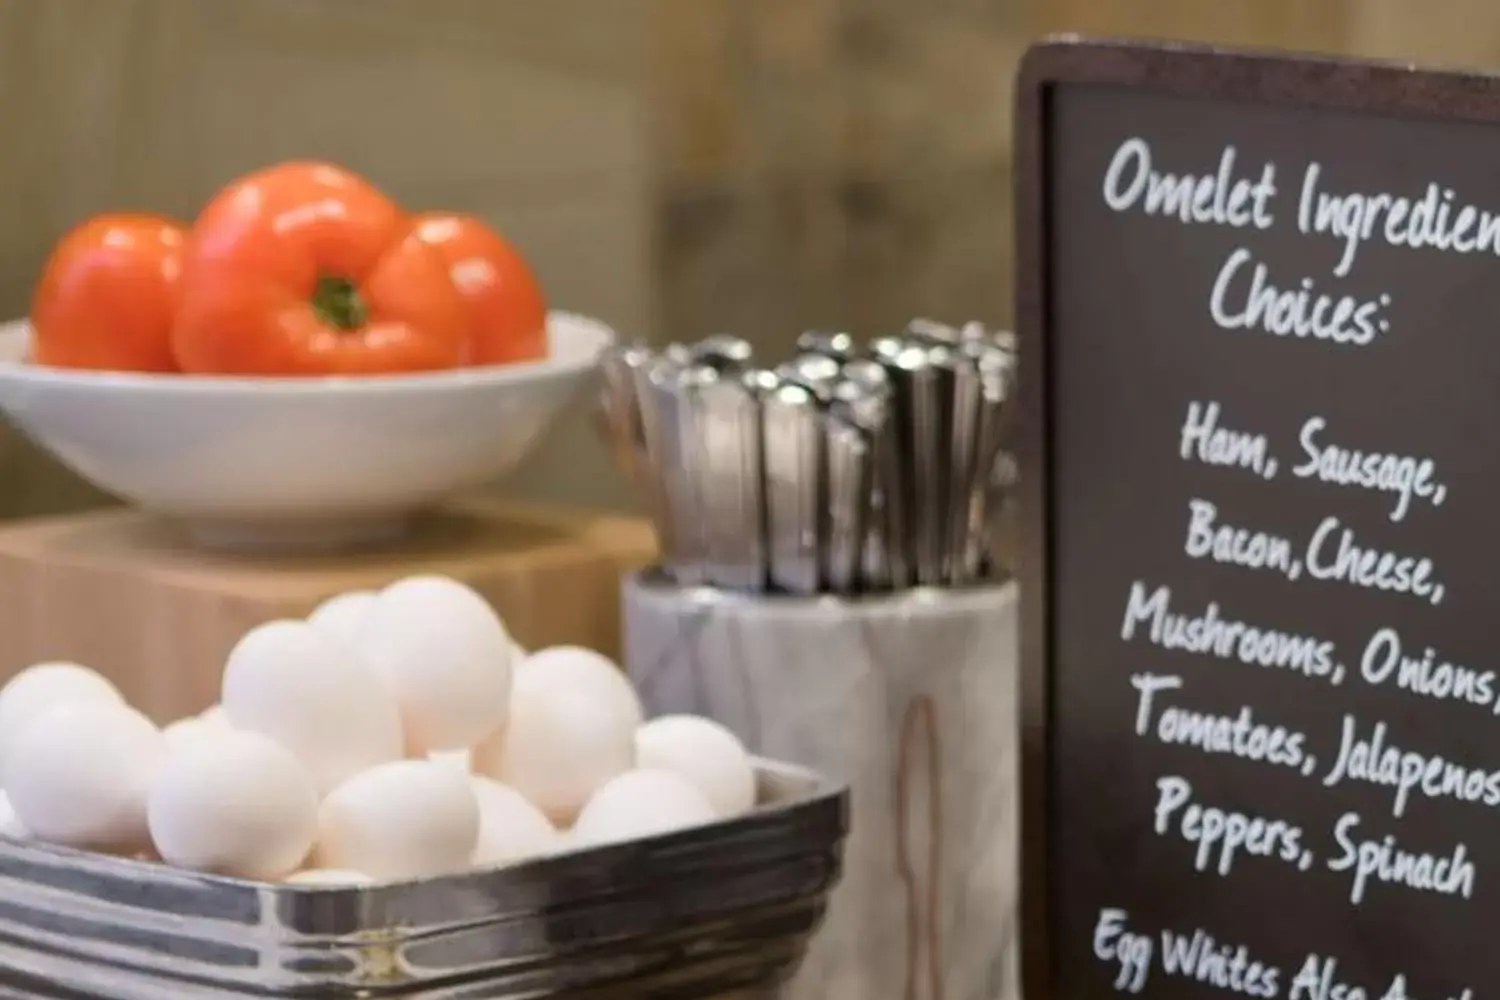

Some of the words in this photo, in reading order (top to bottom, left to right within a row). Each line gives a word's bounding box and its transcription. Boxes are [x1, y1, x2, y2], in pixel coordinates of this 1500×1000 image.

[1103, 137, 1276, 229] Omelet
[1209, 248, 1391, 345] Choices:
[1180, 401, 1278, 480] Ham,
[1292, 416, 1447, 522] Sausage,
[1184, 499, 1302, 581] Bacon,
[1305, 516, 1445, 605] Cheese,
[1121, 581, 1346, 686] Mushrooms,
[1130, 672, 1316, 776] Tomatoes,
[1154, 775, 1313, 876] Peppers,
[1327, 812, 1475, 905] Spinach
[1093, 908, 1153, 994] Egg
[1161, 928, 1280, 999] Whites
